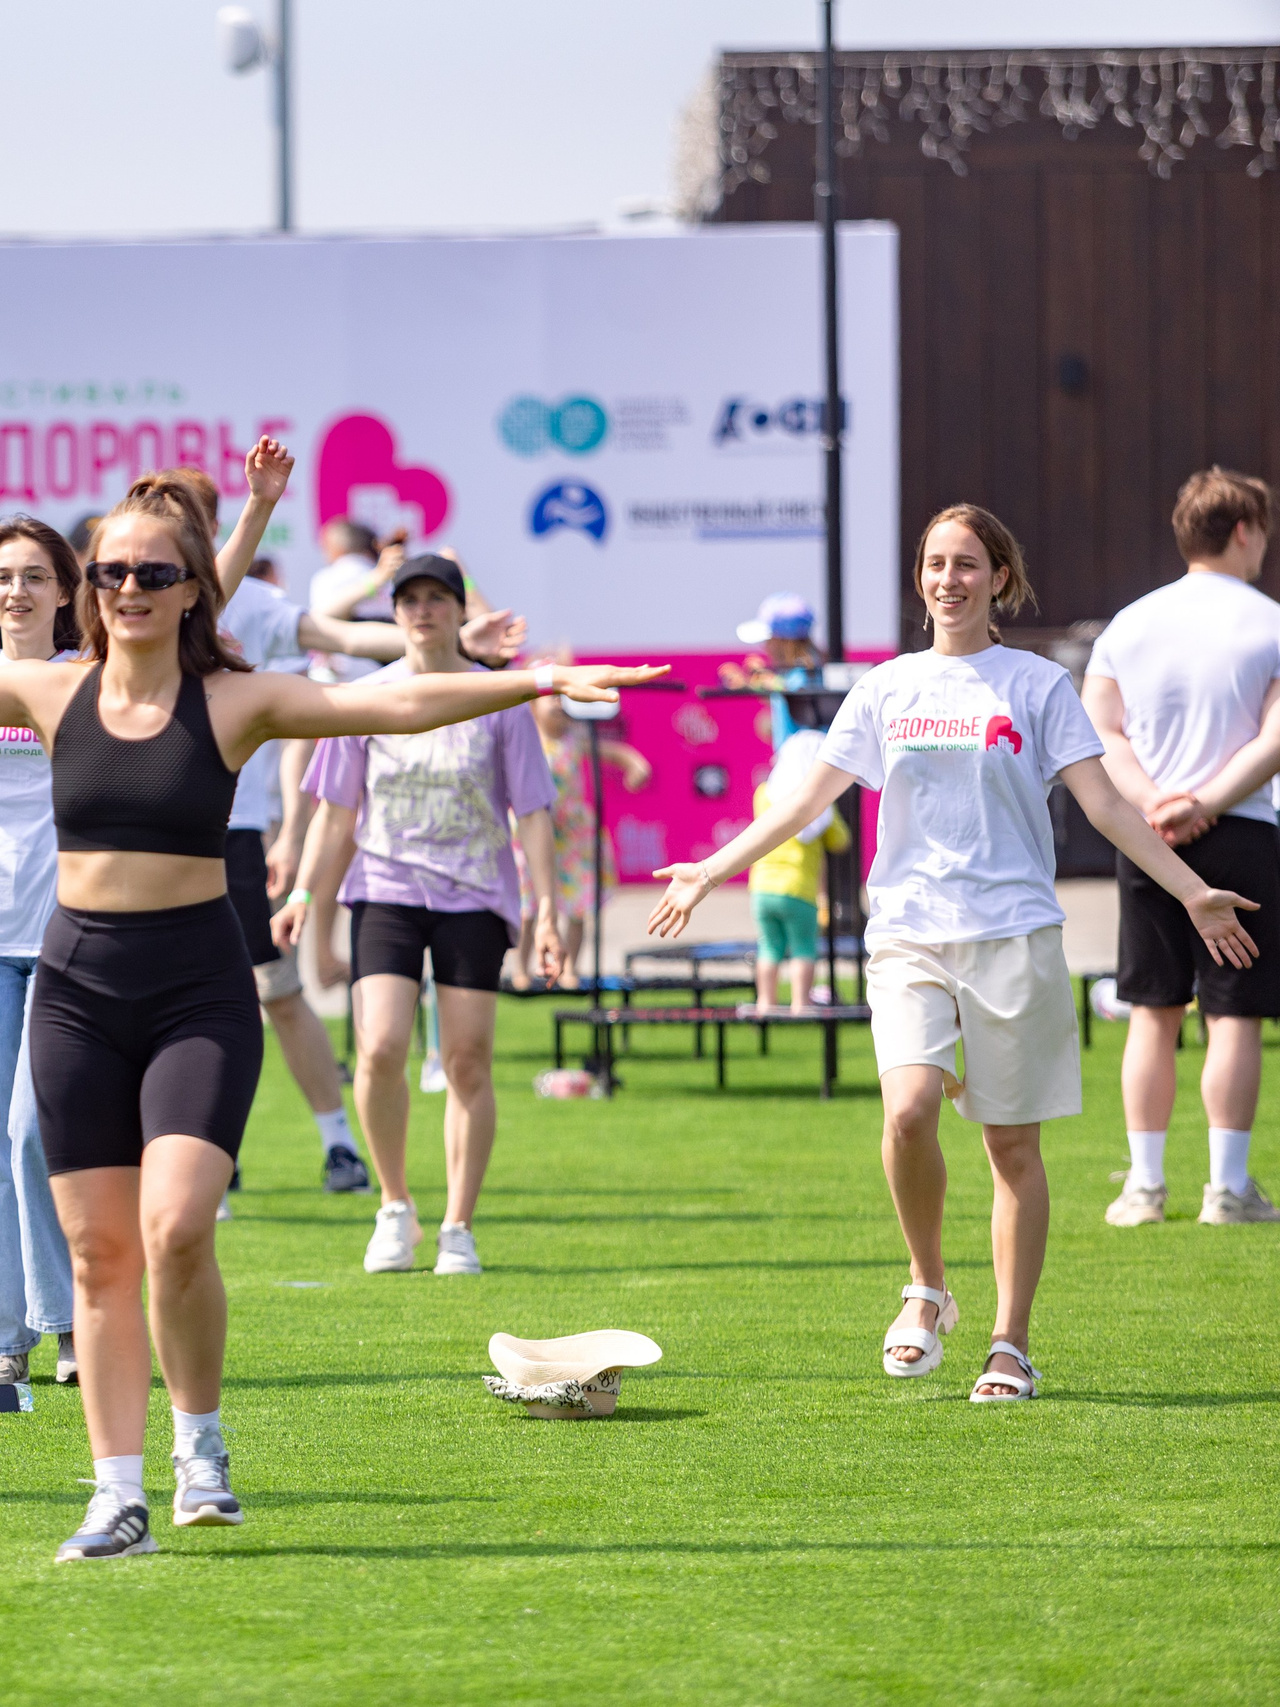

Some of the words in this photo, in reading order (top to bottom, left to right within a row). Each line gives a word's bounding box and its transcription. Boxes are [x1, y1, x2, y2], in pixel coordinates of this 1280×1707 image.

[887, 716, 982, 741] ЗДОРОВЬЕ
[4, 747, 44, 757] ГОРОДЕ
[940, 742, 980, 752] ГОРОДЕ
